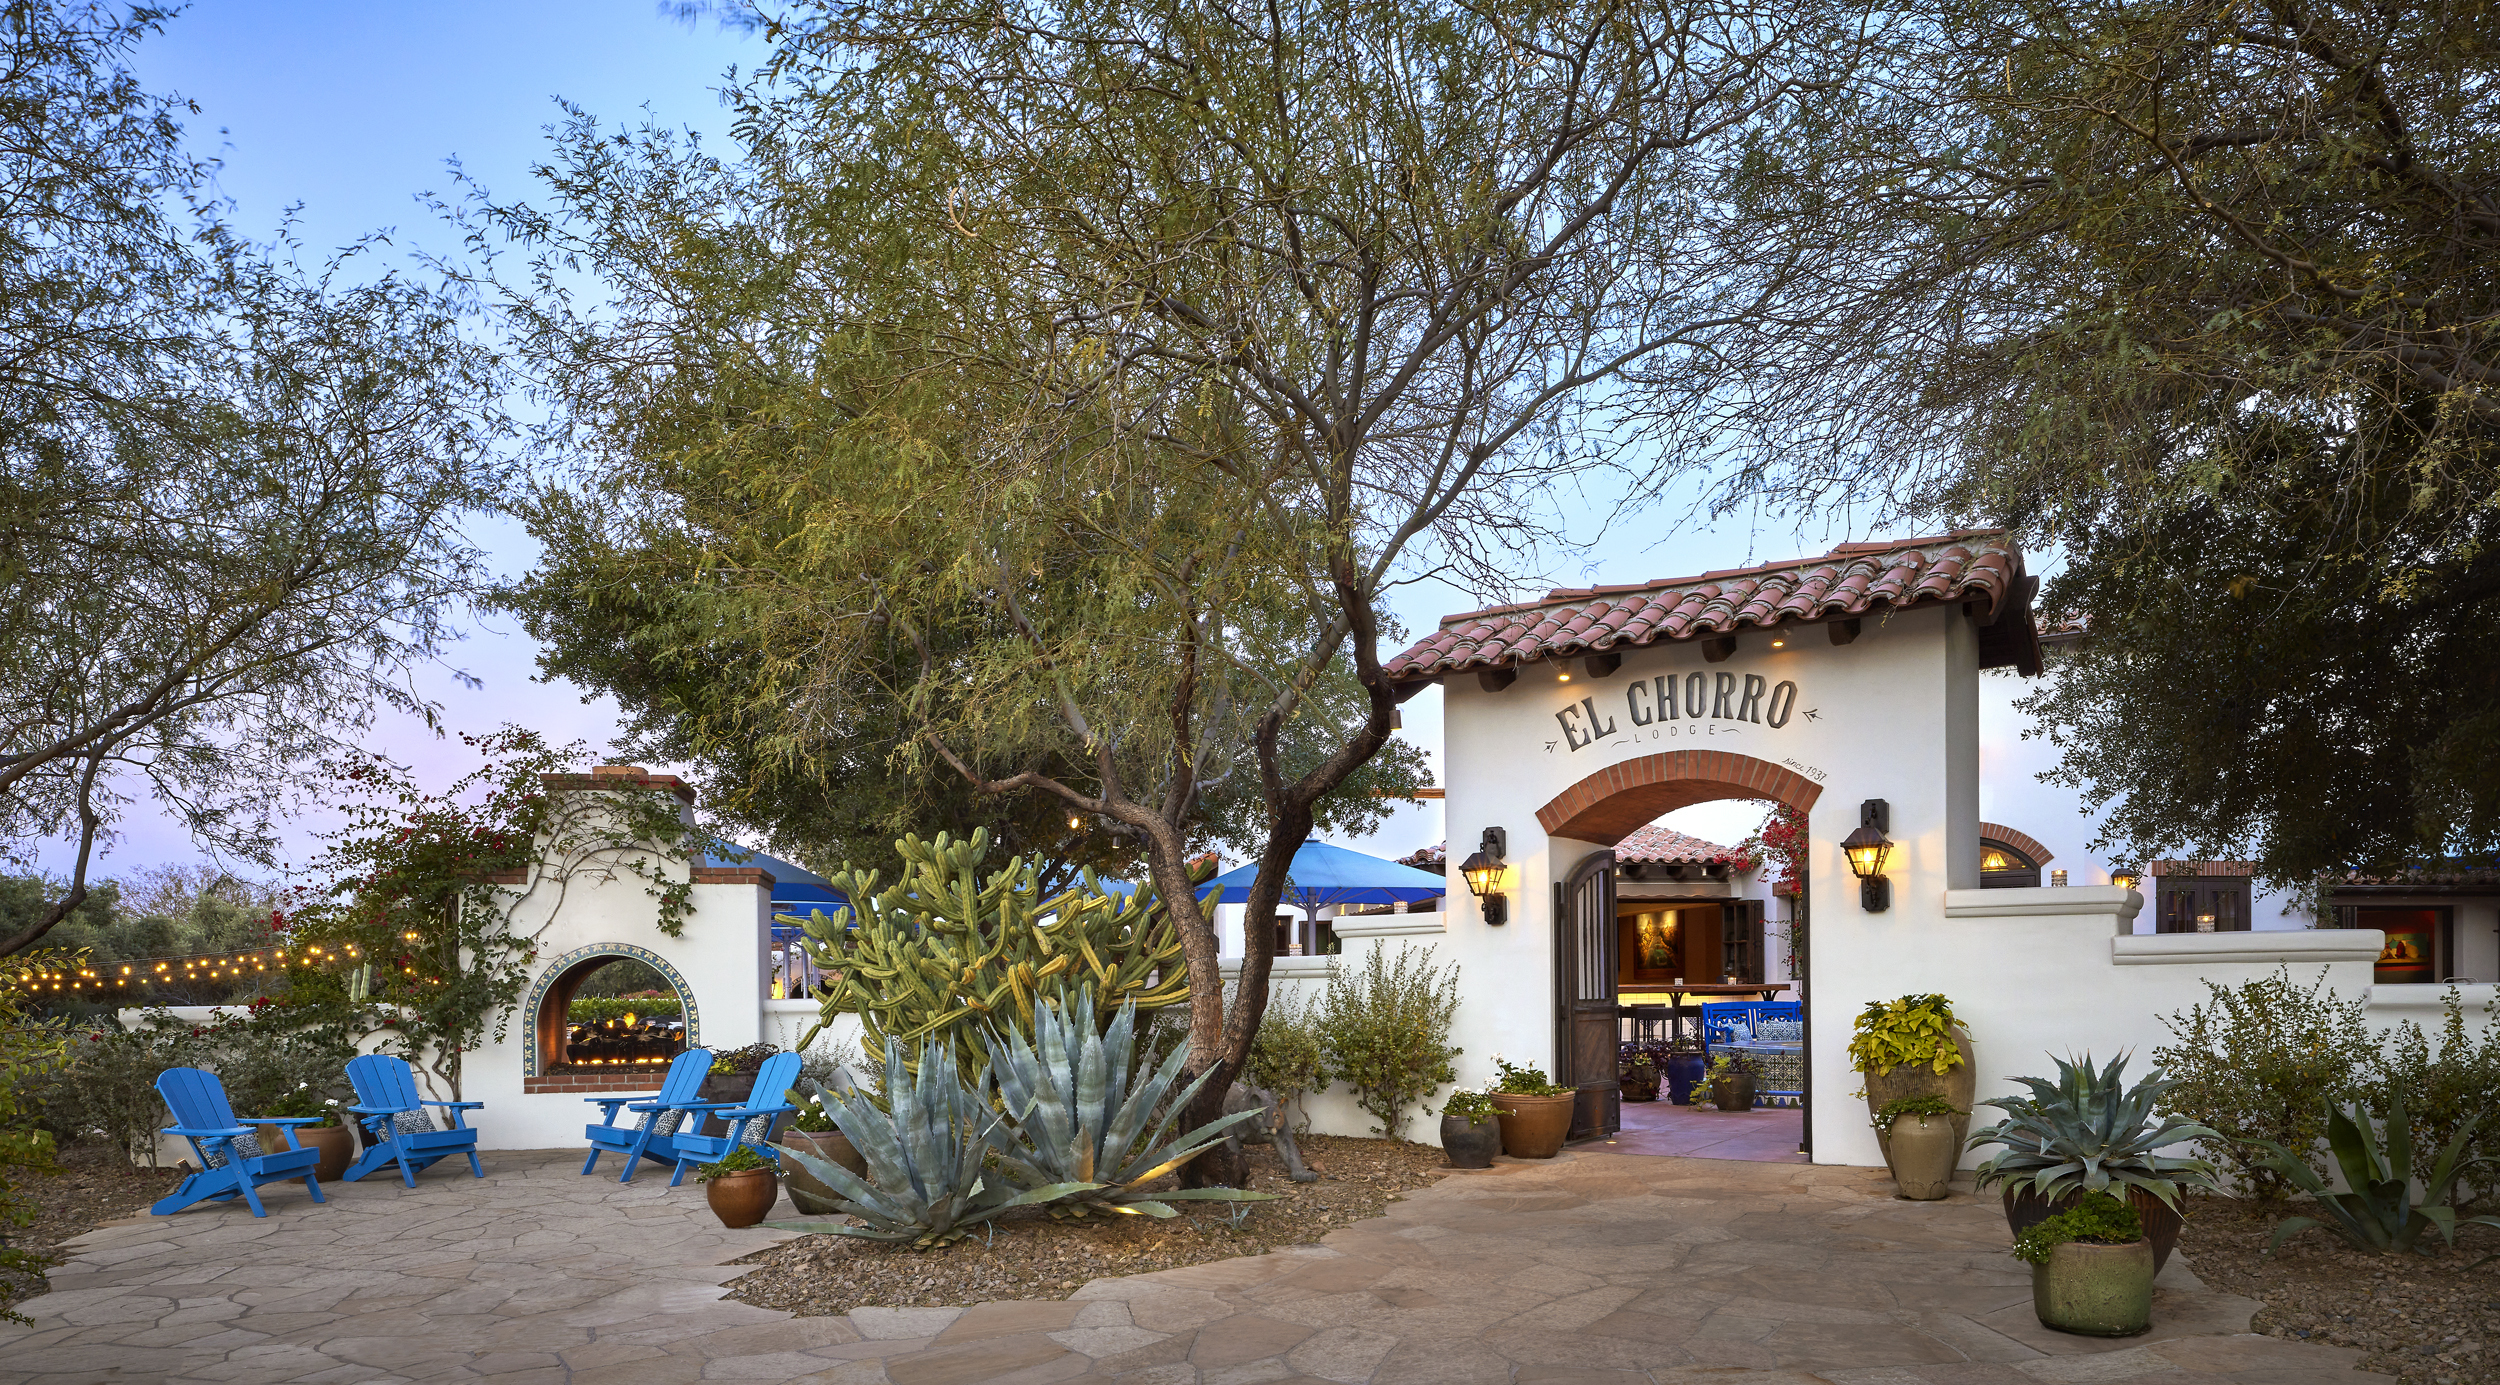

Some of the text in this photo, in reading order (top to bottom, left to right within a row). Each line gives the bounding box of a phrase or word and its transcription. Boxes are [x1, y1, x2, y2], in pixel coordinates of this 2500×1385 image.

[1555, 671, 1798, 752] EL CHORRO
[1634, 725, 1716, 743] LODGE
[1781, 757, 1828, 782] since 1937
